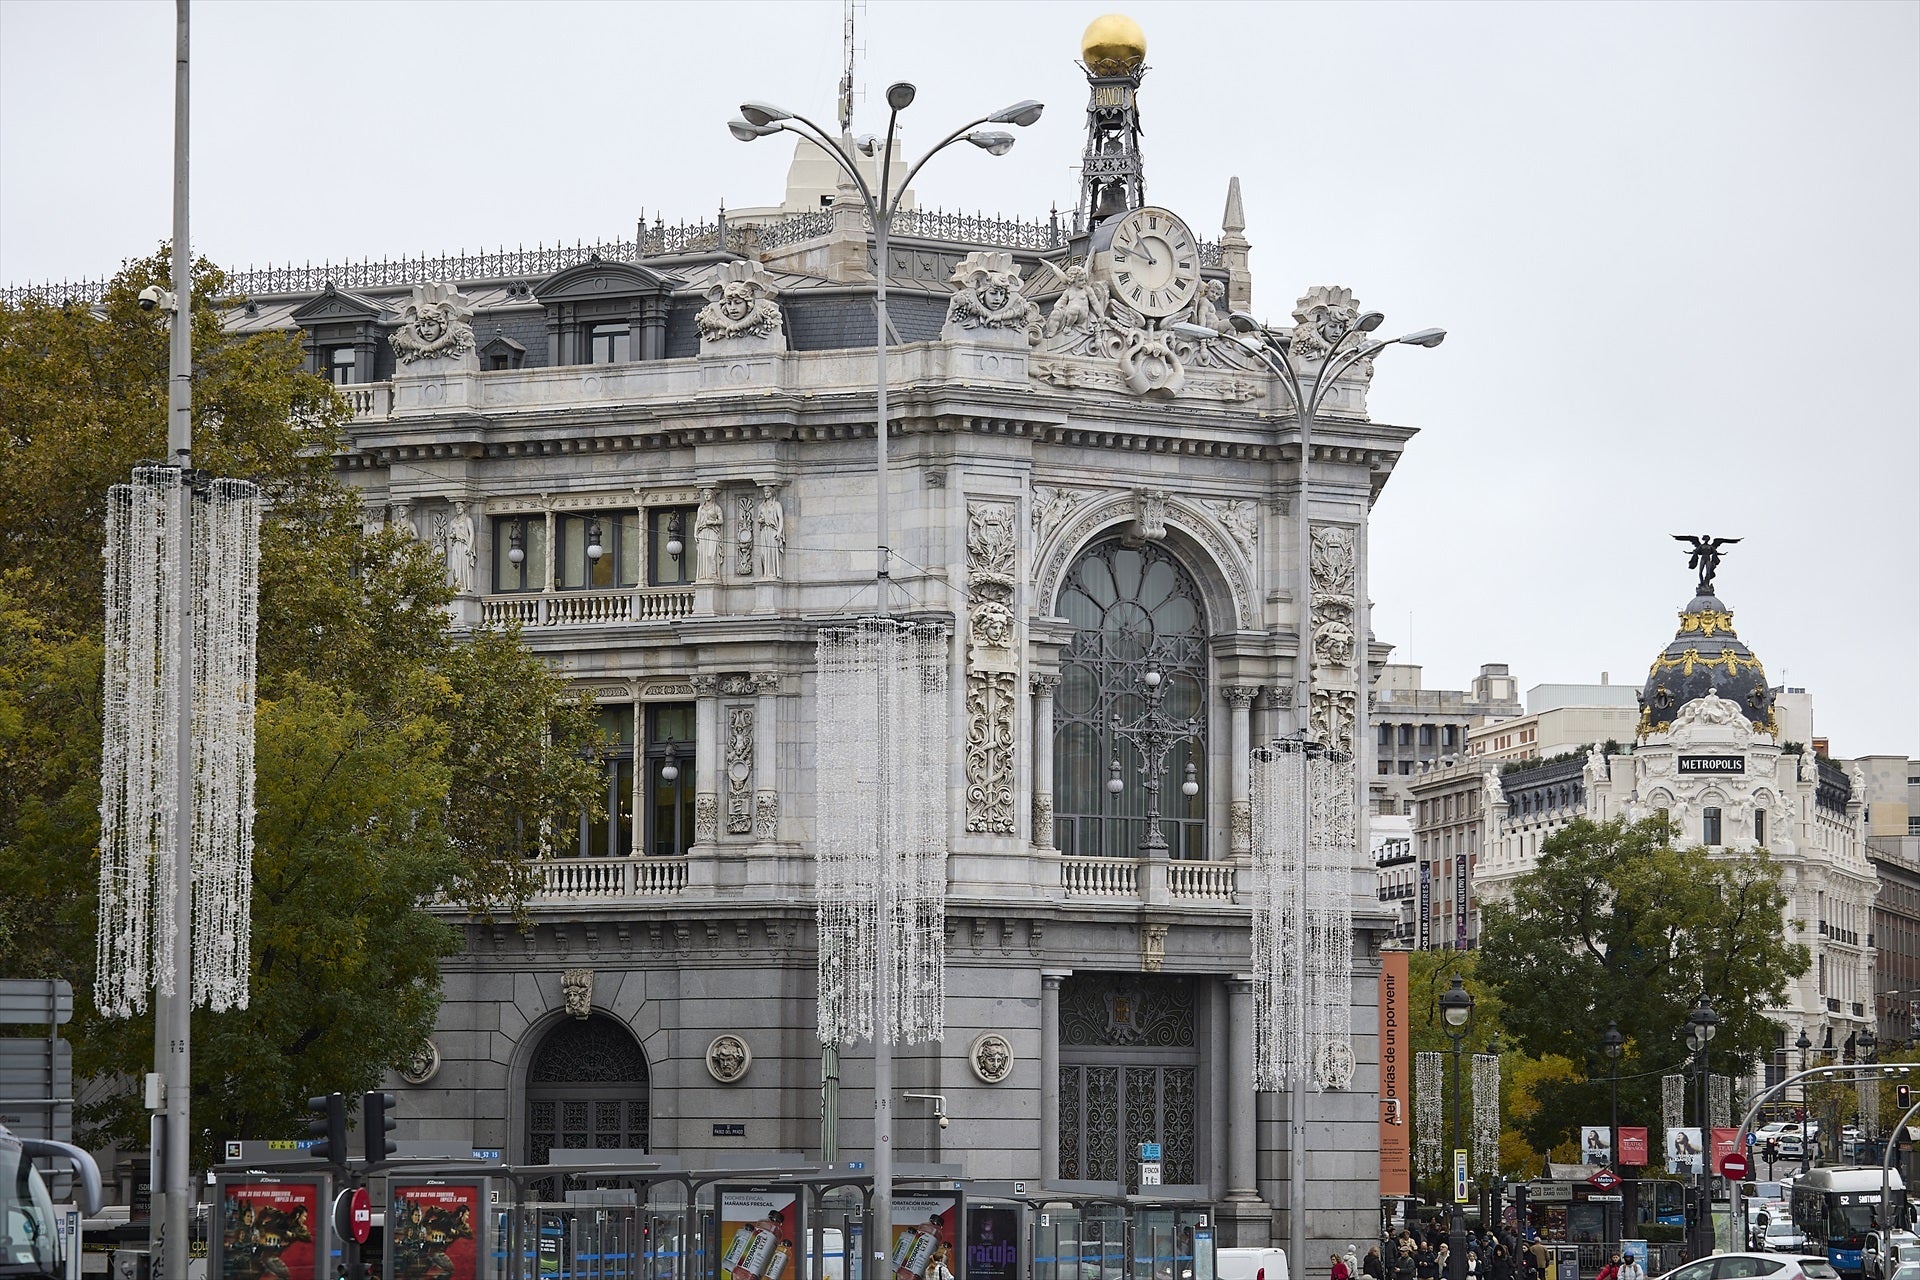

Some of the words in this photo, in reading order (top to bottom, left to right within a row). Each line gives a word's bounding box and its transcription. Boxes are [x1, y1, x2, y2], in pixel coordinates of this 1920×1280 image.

[1096, 86, 1124, 106] BANCO
[1682, 759, 1742, 770] METROPOLIS
[1384, 974, 1397, 1027] porvenir
[1386, 1030, 1395, 1045] un
[1384, 1048, 1395, 1063] de
[1840, 1195, 1850, 1205] 52
[743, 1235, 762, 1268] BODYARMOR
[906, 1237, 924, 1268] BODYARMOR
